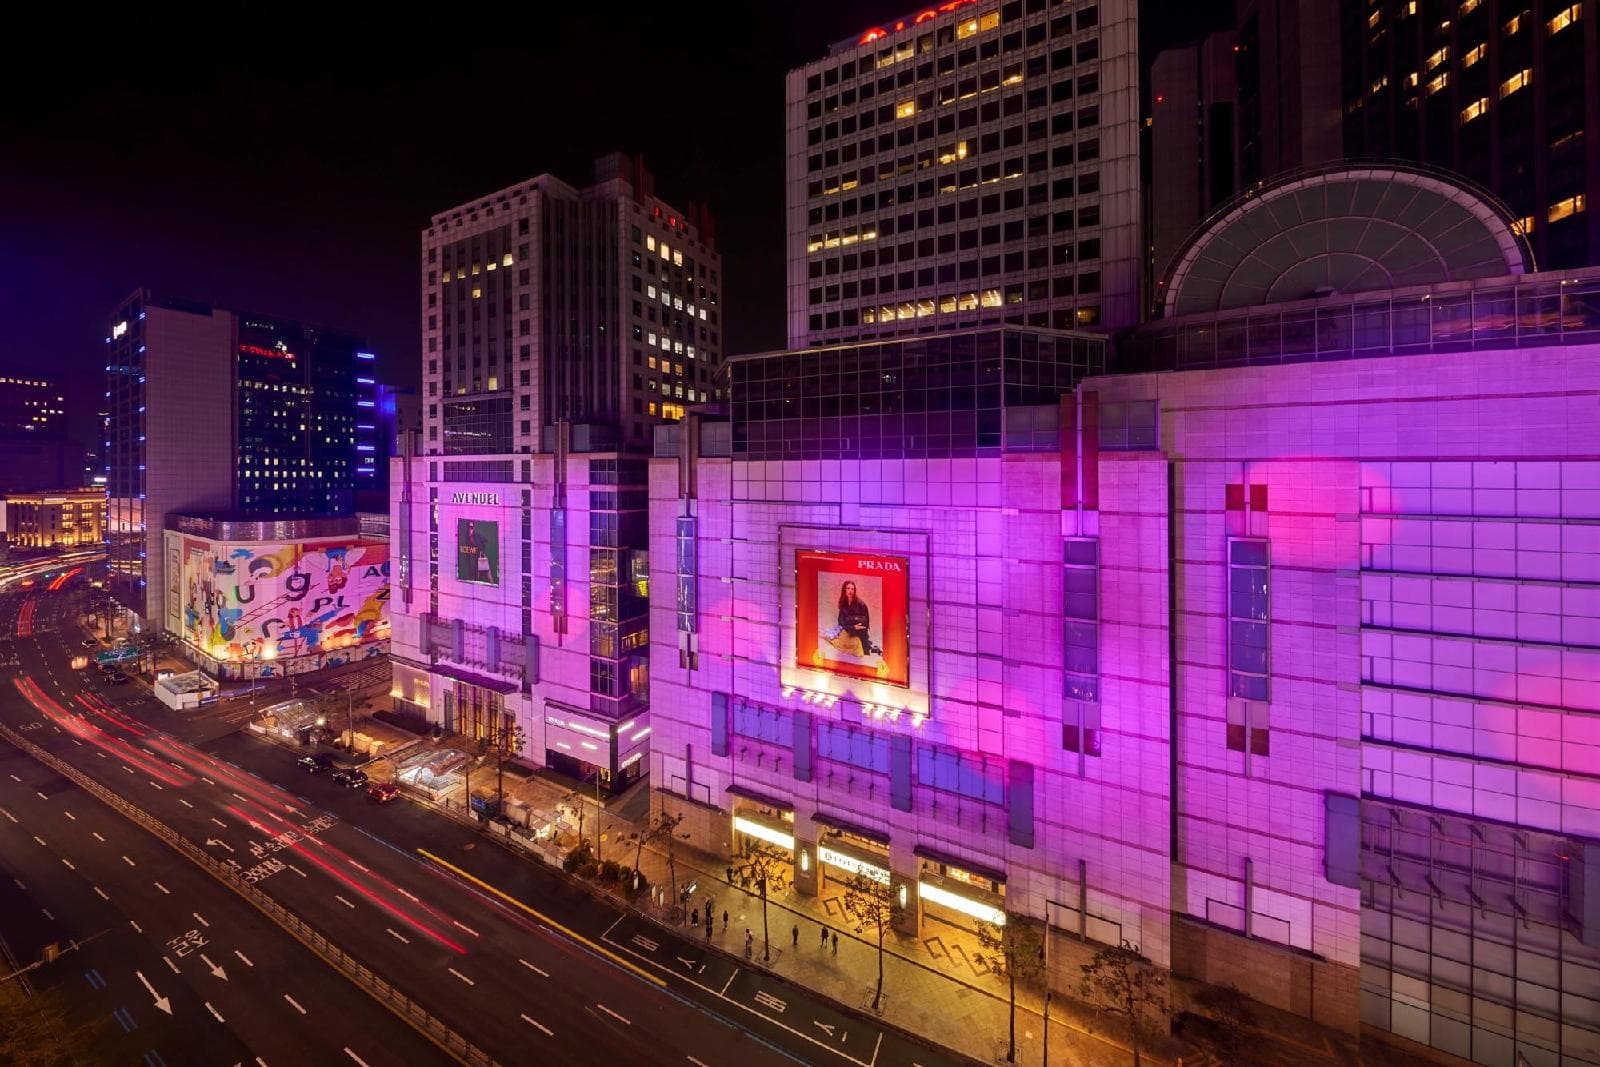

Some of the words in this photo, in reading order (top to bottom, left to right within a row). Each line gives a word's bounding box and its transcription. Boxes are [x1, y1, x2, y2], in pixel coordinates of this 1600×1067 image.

[452, 492, 499, 505] AVENUEL
[857, 559, 902, 572] PRADA
[165, 929, 210, 958] 종로
